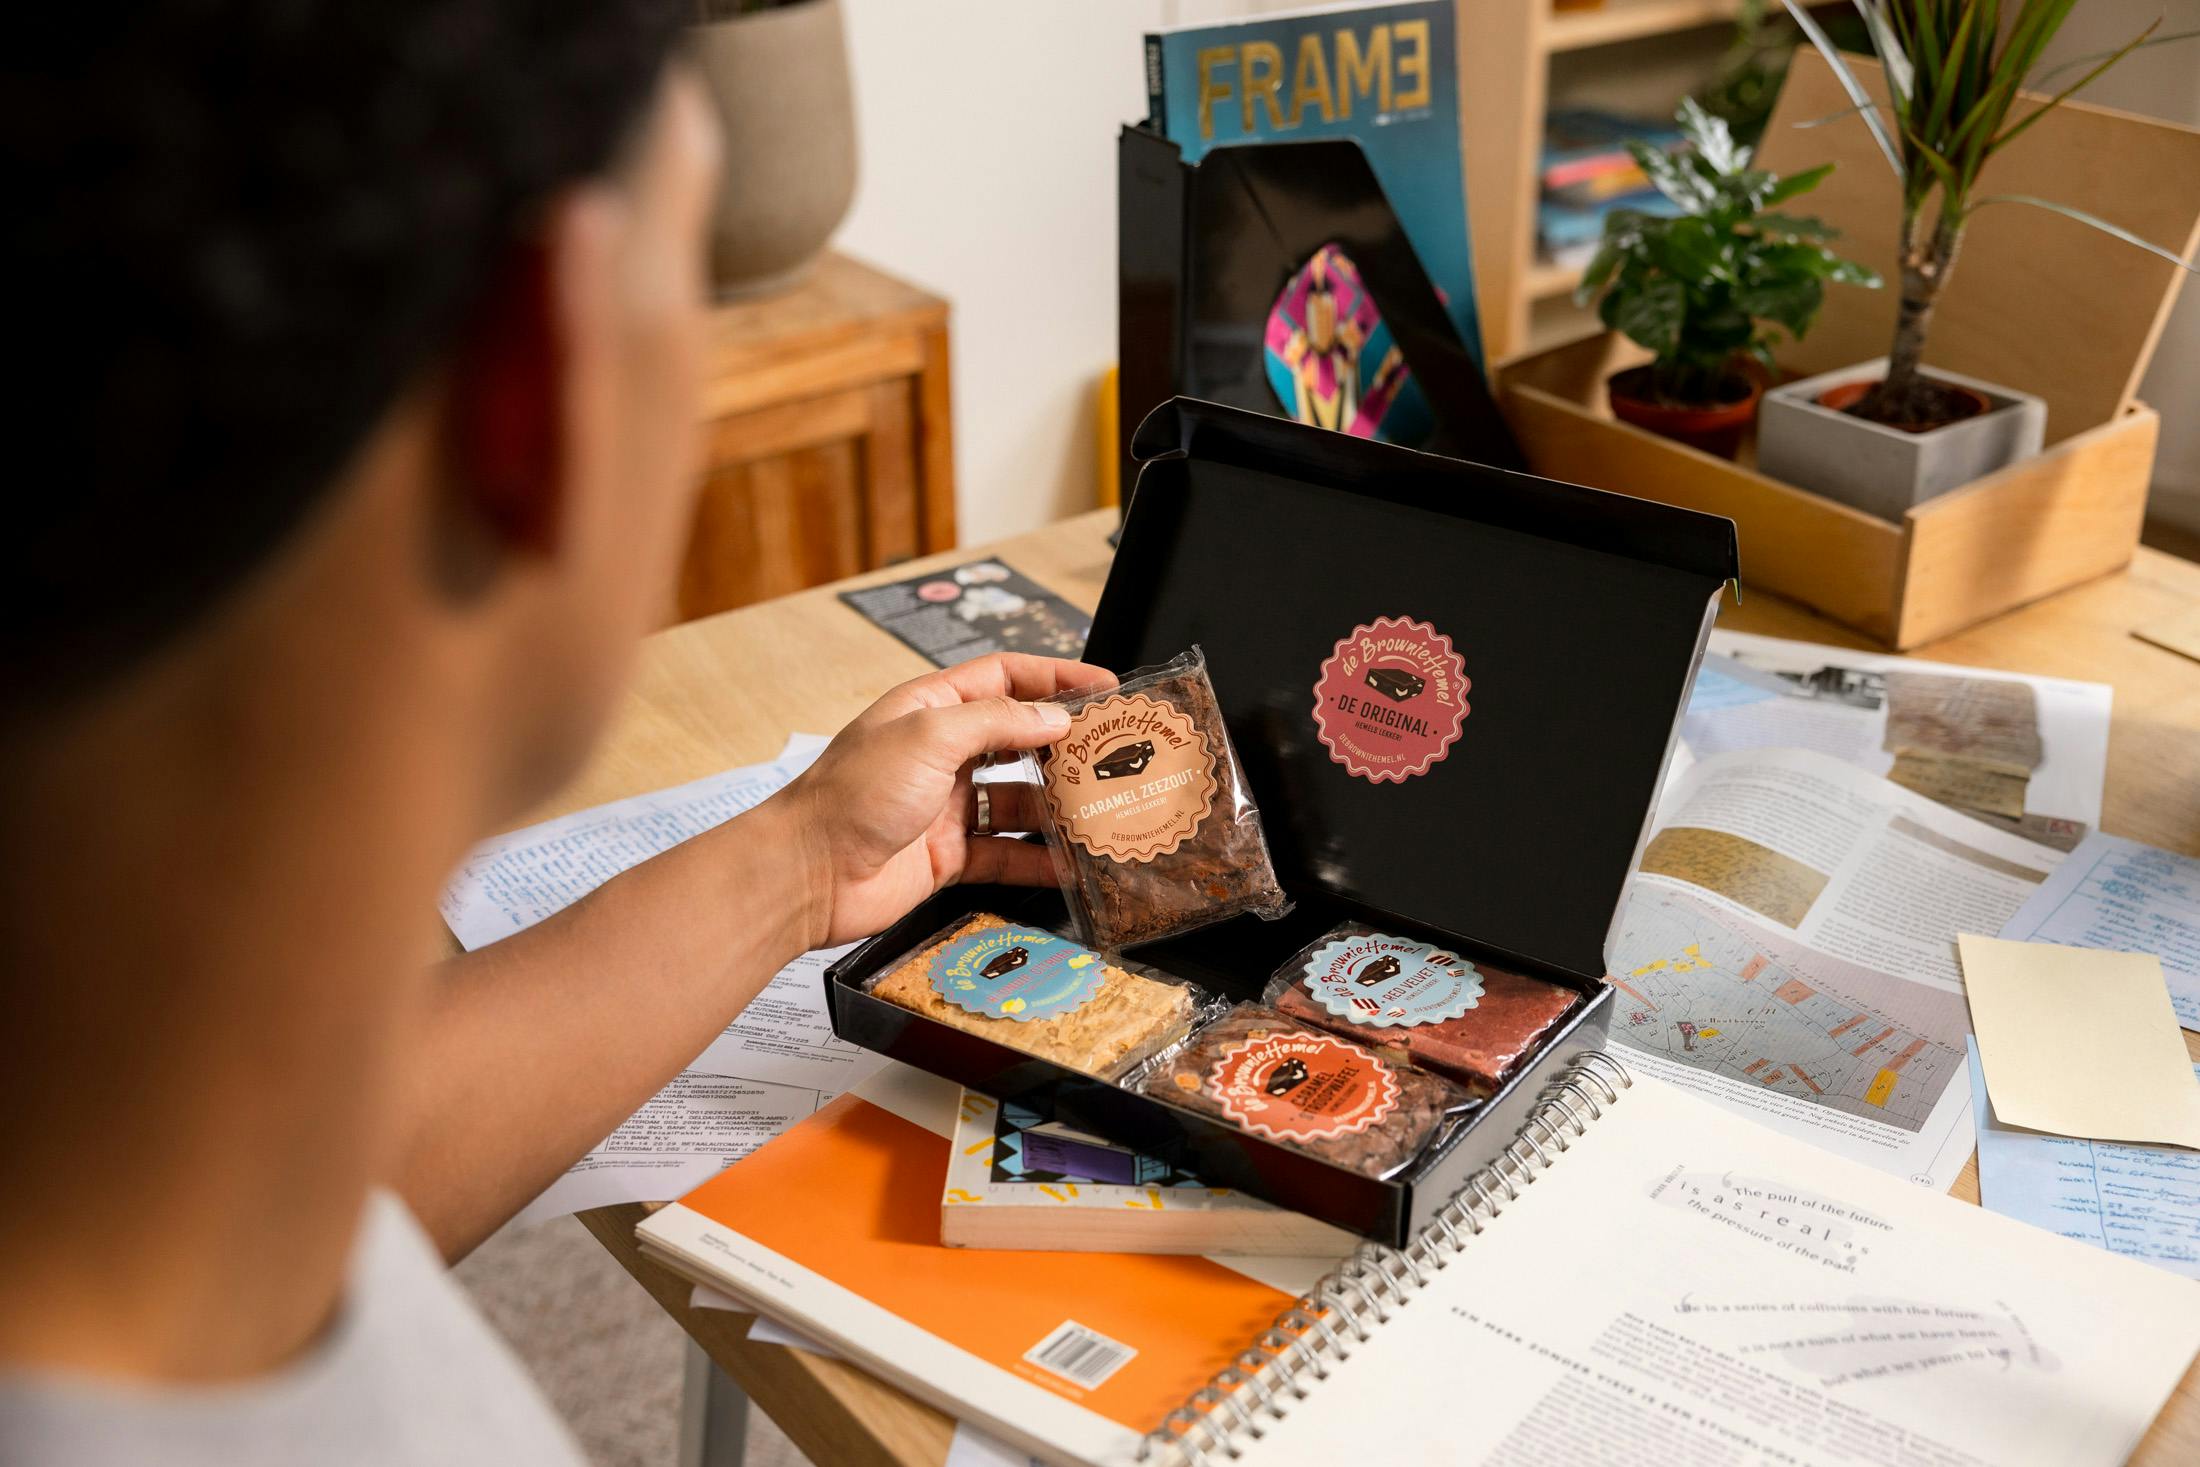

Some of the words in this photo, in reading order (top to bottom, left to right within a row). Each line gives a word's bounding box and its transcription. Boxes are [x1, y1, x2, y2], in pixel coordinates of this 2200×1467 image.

[1342, 651, 1359, 677] de
[1337, 694, 1359, 714] DE
[1360, 702, 1429, 738] ORIGINAL
[1338, 732, 1406, 764] DEBROWNIEHEMEL.NL
[1061, 761, 1080, 785] de
[1079, 789, 1140, 820] CARAMEL
[1140, 769, 1195, 799] ZEEZOUT
[1111, 809, 1185, 842] DEBROWNIEHEMEL.NL
[1115, 806, 1142, 820] HEMELS
[1382, 986, 1407, 1002] RED
[1402, 966, 1437, 991] VELVET
[1732, 1186, 1763, 1199] The
[1767, 1191, 1798, 1205] pull
[1801, 1197, 1819, 1210] of
[1821, 1202, 1846, 1217] the
[1848, 1211, 1895, 1232] future
[1687, 1197, 1711, 1215] the
[1711, 1210, 1774, 1243] pressure
[1776, 1238, 1793, 1251] of
[1794, 1246, 1820, 1261] the
